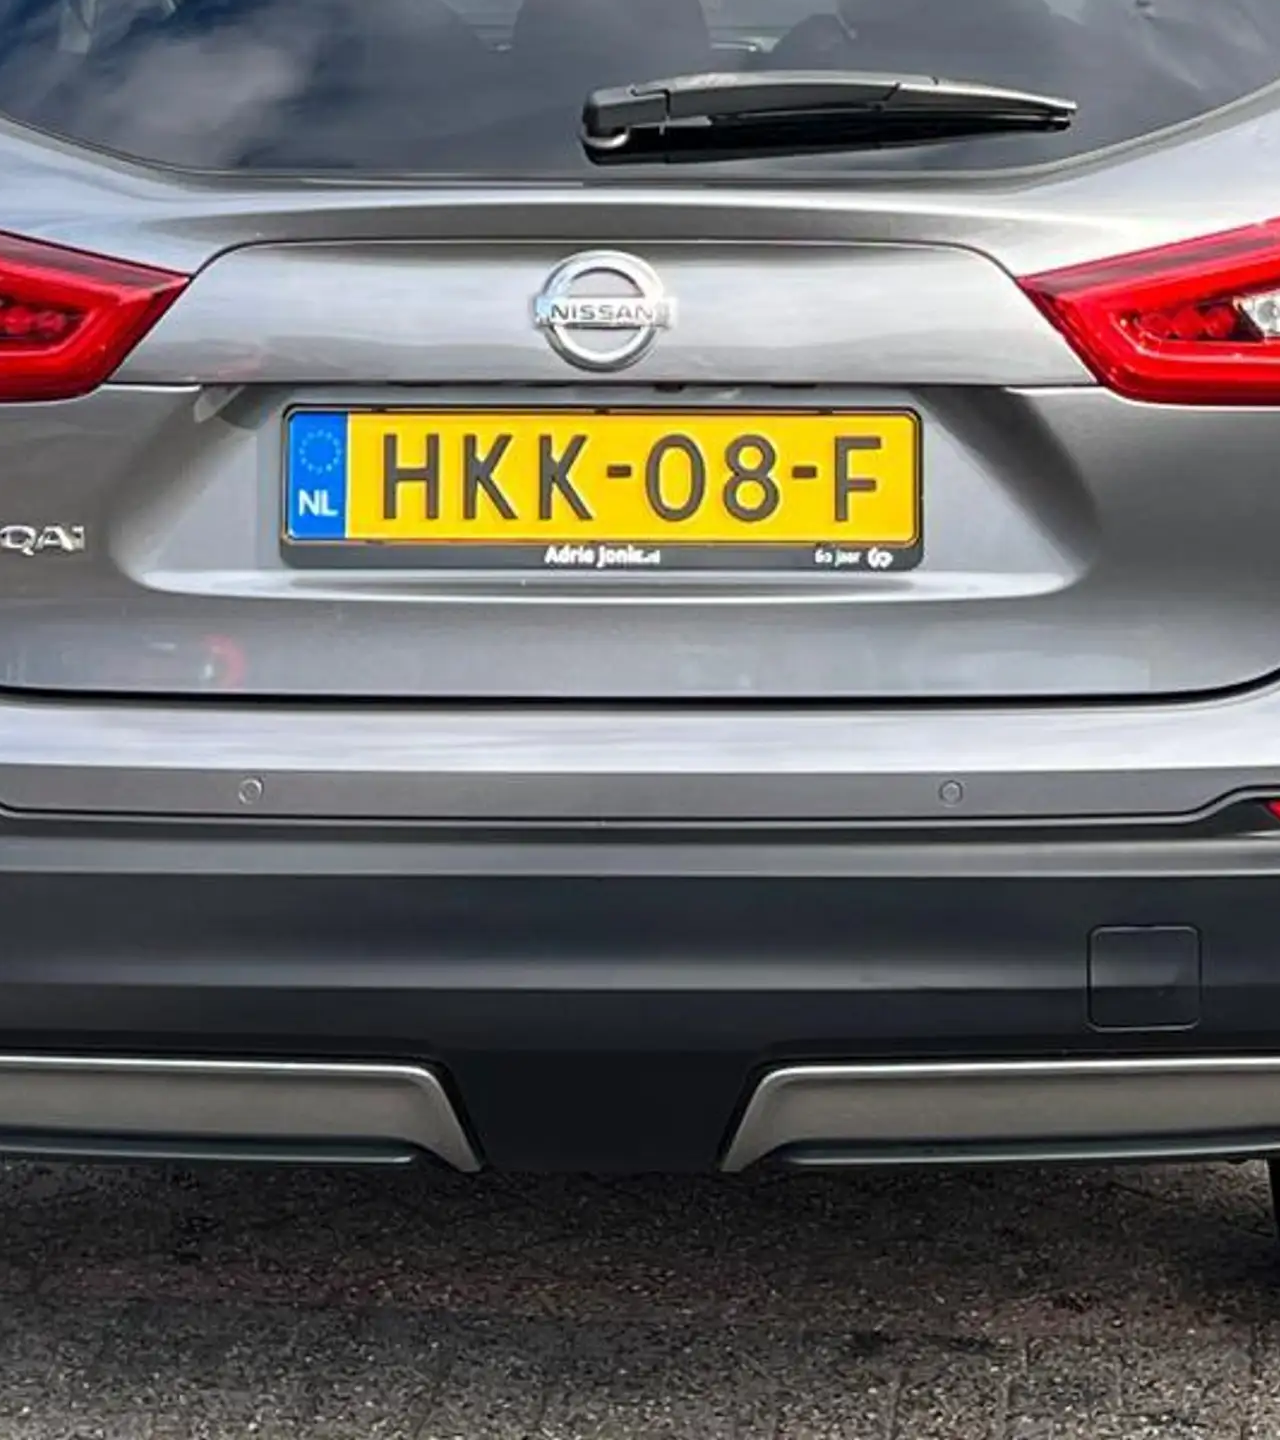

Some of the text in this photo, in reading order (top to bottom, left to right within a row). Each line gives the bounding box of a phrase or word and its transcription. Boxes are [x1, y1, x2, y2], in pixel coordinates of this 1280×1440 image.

[550, 304, 654, 321] NISSAN
[382, 432, 883, 523] HKK-08-F
[298, 488, 340, 517] NL
[543, 544, 595, 564] Adrie
